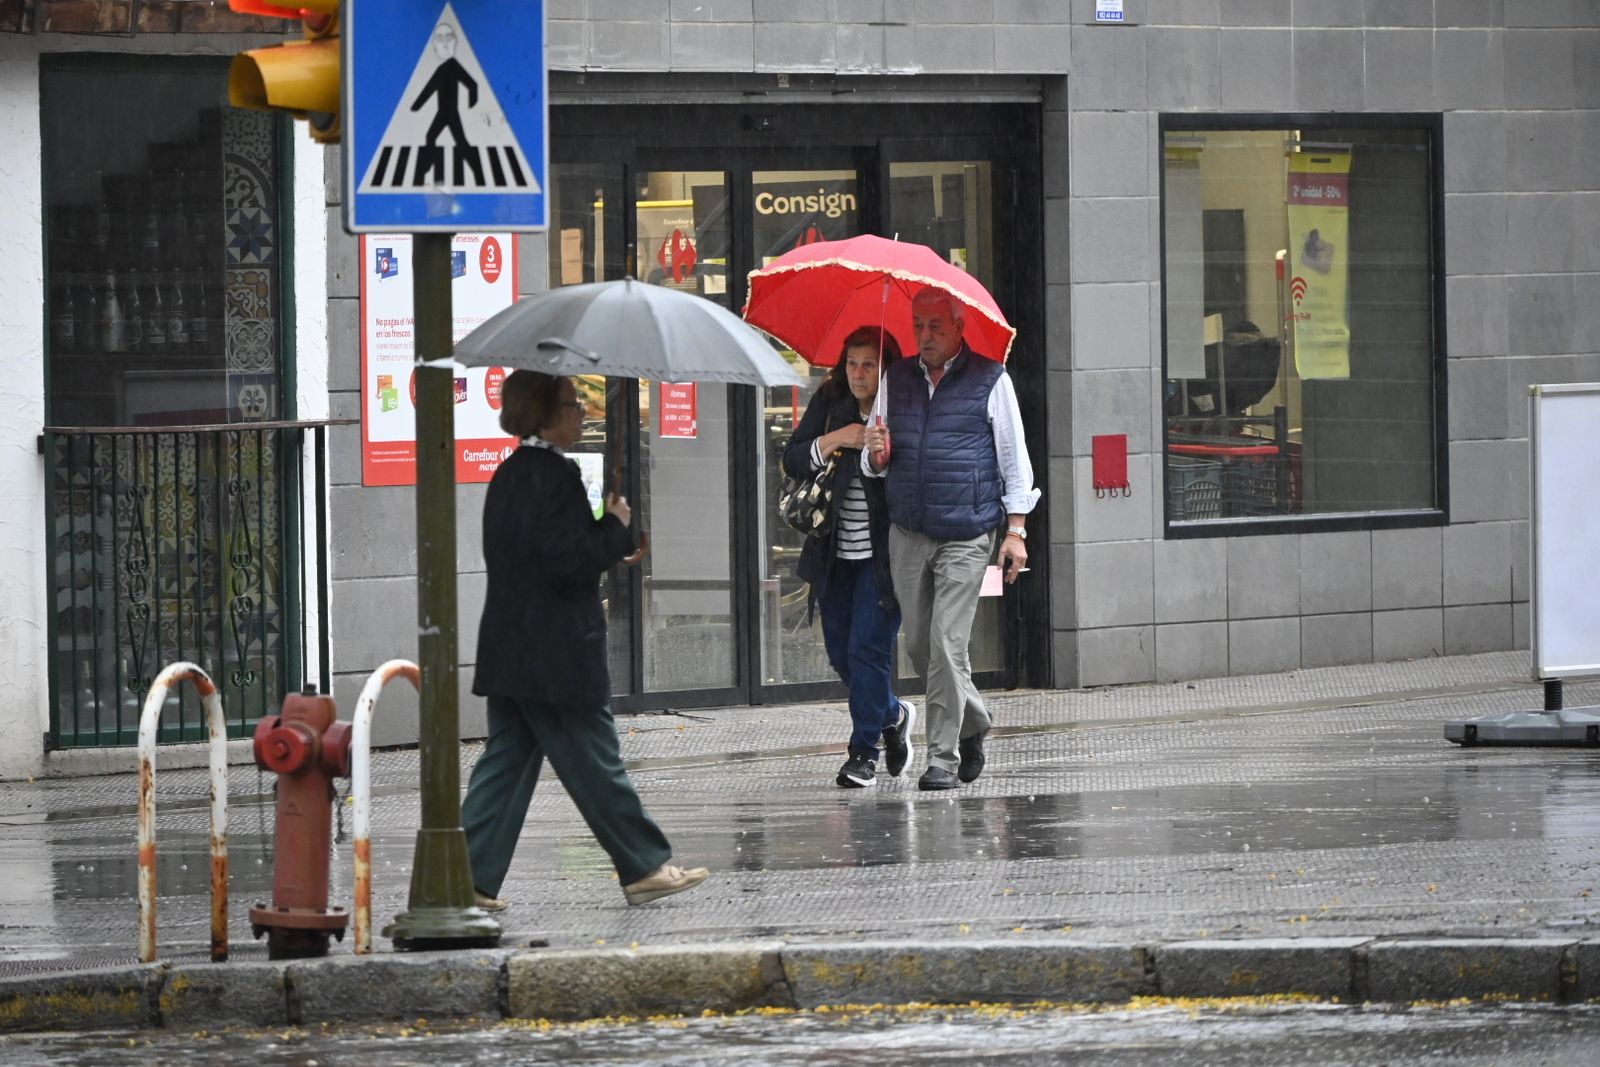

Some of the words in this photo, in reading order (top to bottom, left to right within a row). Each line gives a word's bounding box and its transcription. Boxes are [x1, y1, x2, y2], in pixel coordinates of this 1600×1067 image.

[1301, 185, 1322, 198] unidad
[755, 188, 856, 218] Consign
[456, 235, 479, 243] intereses
[487, 244, 495, 263] 3
[375, 317, 384, 326] No
[384, 318, 400, 328] pagas
[392, 330, 411, 338] frescos
[463, 449, 498, 462] Carrefour
